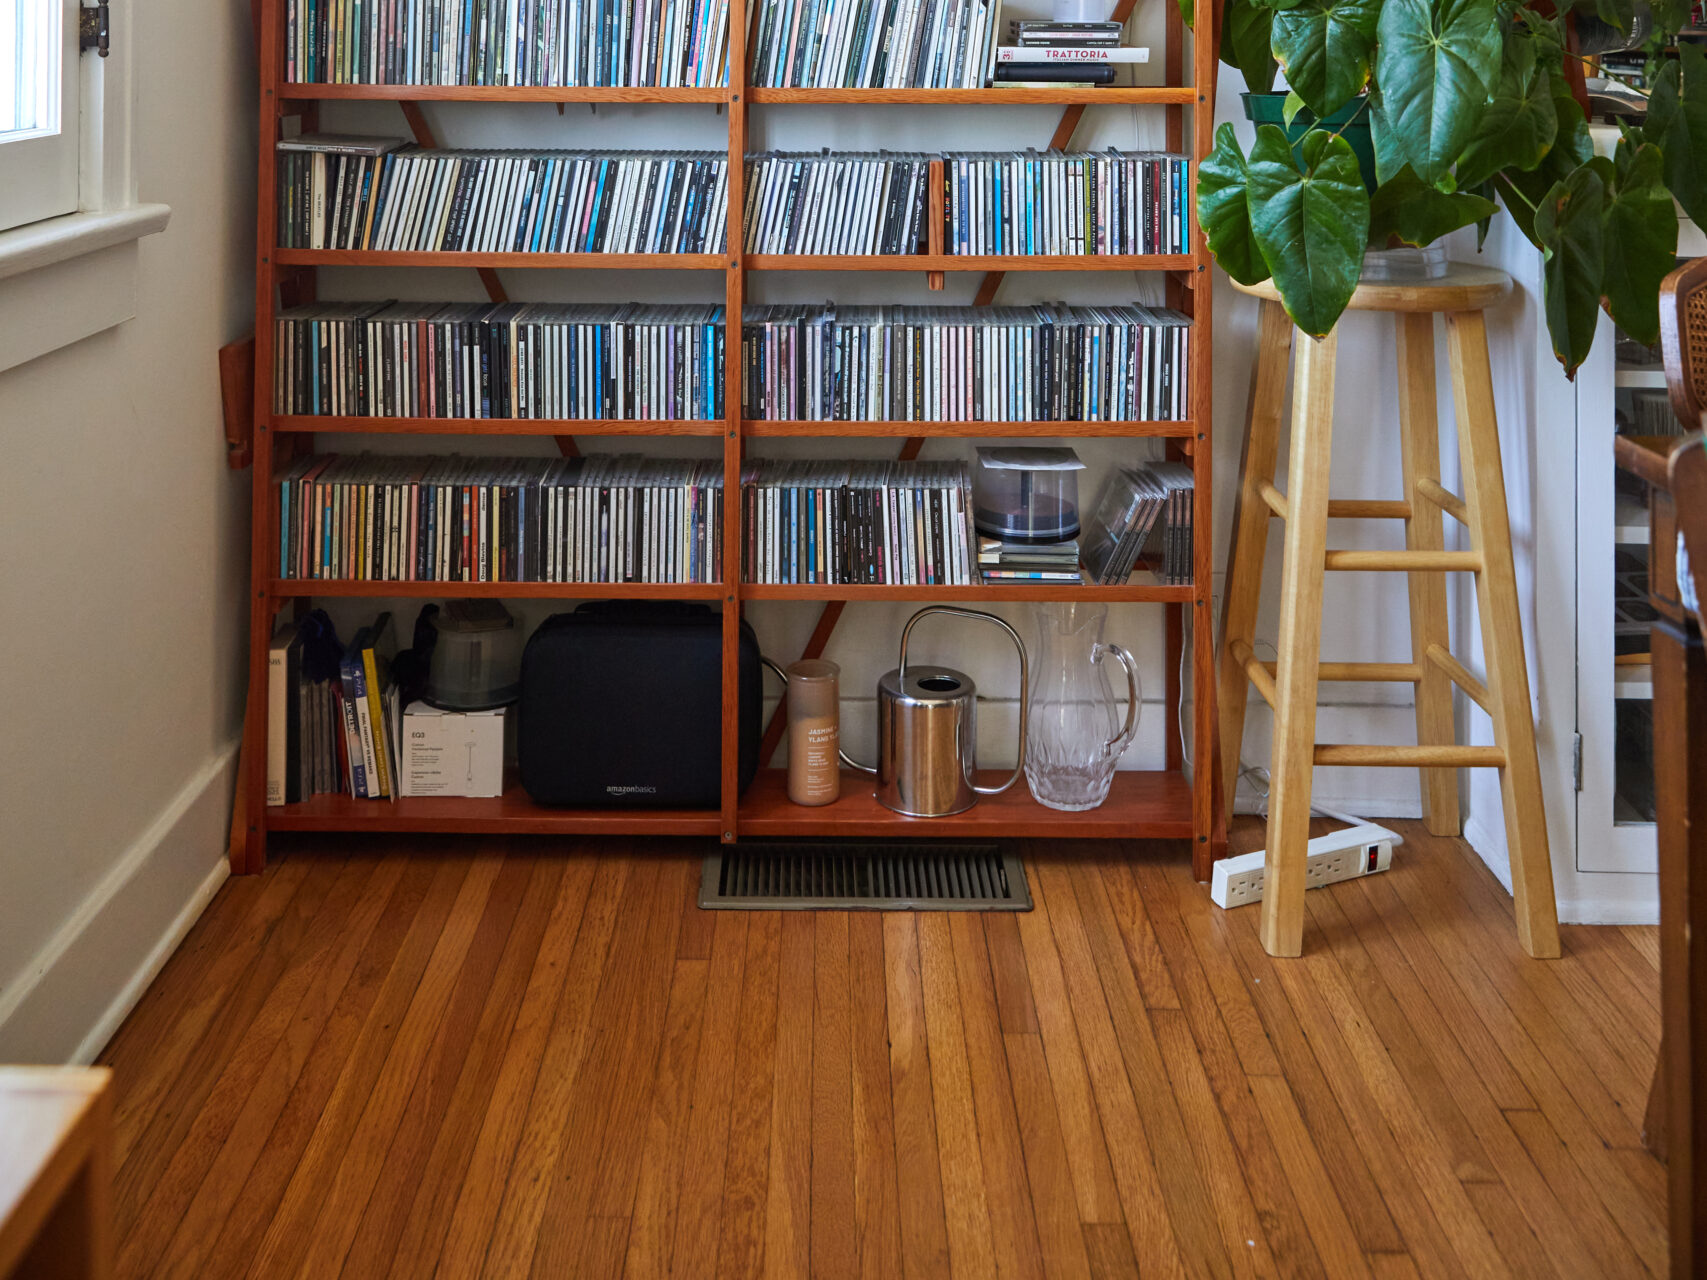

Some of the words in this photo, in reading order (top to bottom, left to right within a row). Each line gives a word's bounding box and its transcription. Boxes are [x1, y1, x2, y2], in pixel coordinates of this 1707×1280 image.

[1045, 50, 1108, 58] TRATTORIA
[345, 701, 355, 734] DETROIT
[606, 785, 657, 794] amazonbasics
